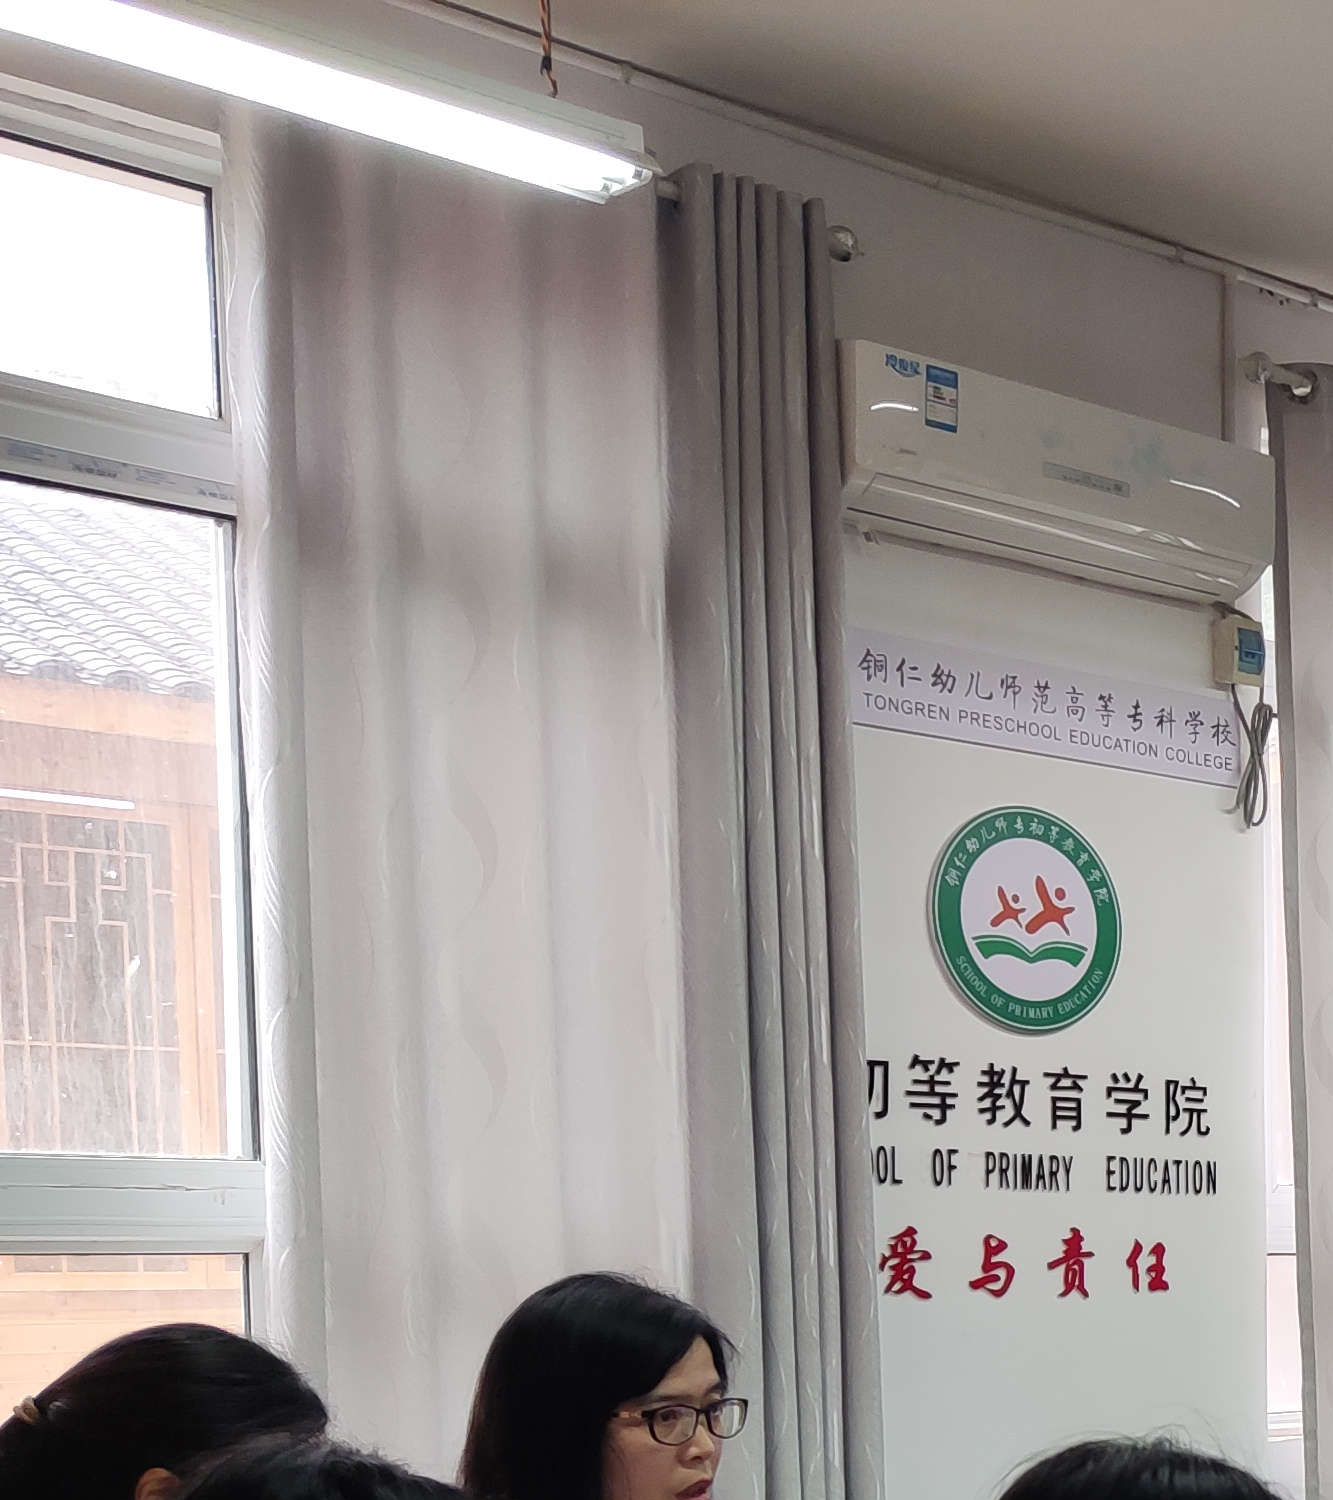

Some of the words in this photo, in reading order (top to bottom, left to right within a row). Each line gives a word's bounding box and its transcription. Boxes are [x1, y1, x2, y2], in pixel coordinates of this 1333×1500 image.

[858, 648, 1236, 748] 铜仁幼儿师范高等专科学校
[863, 692, 950, 721] TONGREN
[958, 709, 1062, 741] PRESCHOOL
[1069, 730, 1159, 758] EDUCATION
[1165, 746, 1233, 772] COLLEGE
[944, 816, 1109, 906] 铜仁幼儿师专初等教育学院
[956, 956, 987, 997] SCHOOL
[990, 994, 1006, 1008] OF
[1008, 1002, 1055, 1019] PRIMARY
[1057, 967, 1104, 1015] EDUCATION
[932, 1149, 959, 1186] OF
[985, 1152, 1073, 1192] PRIMARY
[1106, 1157, 1217, 1195] EDUCATION
[879, 1226, 1171, 1300] 爱与责任
